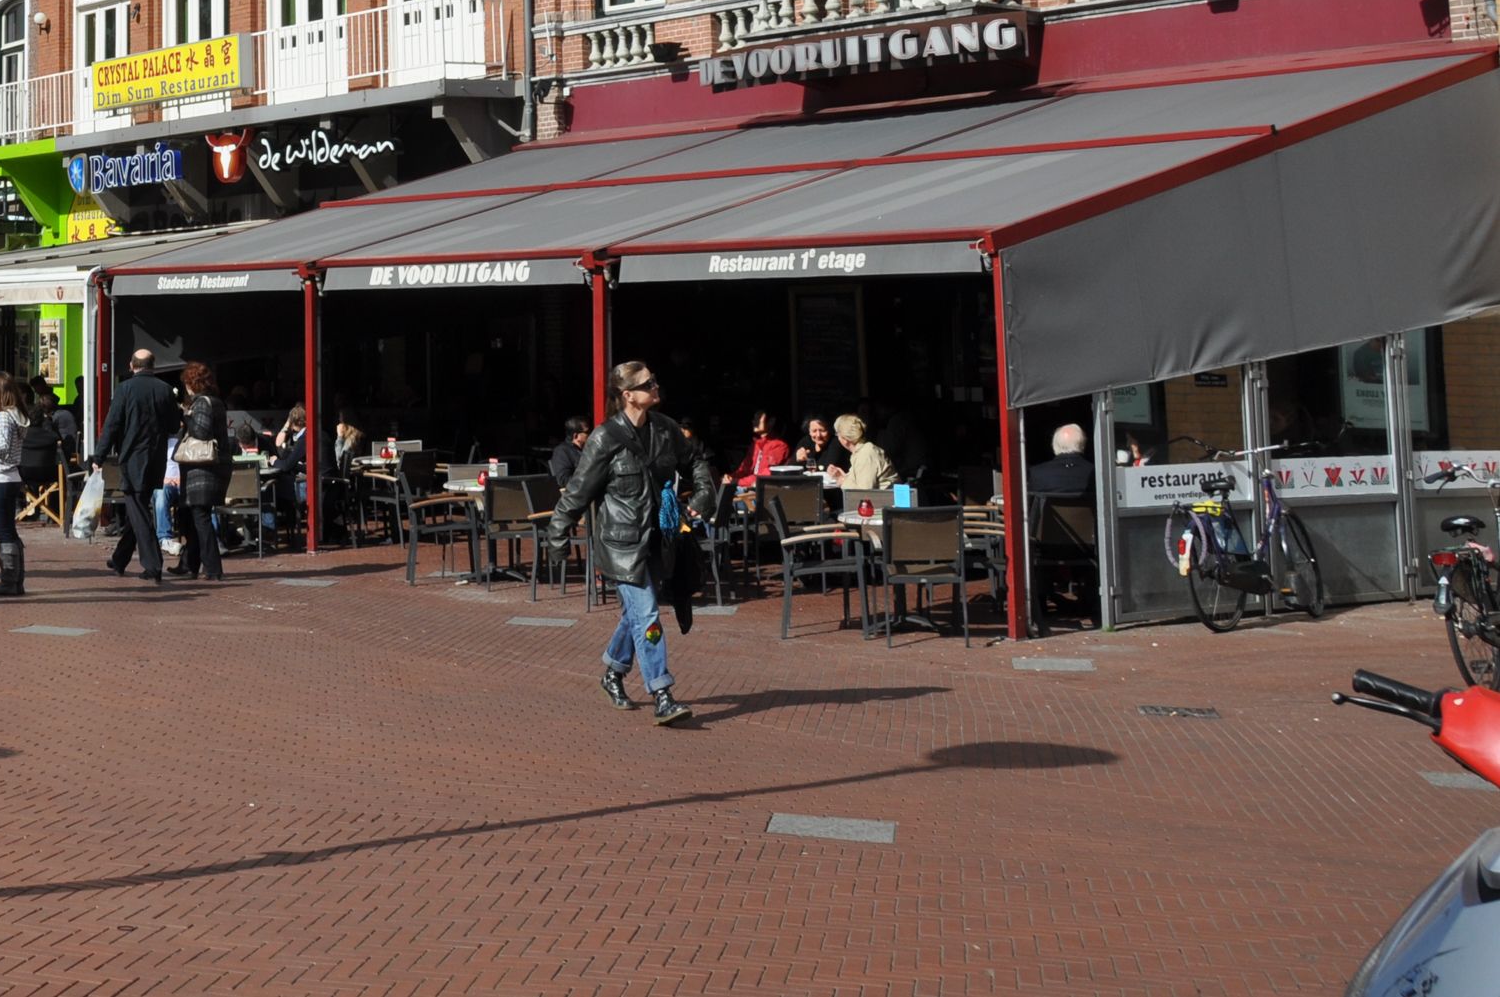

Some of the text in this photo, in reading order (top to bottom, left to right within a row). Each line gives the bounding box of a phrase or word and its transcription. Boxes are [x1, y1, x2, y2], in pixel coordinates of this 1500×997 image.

[700, 18, 1017, 87] DE VOORUITGANG
[97, 51, 182, 87] CRYSTAL PALACE
[97, 69, 236, 107] Dim Sum Restaurant
[258, 129, 395, 172] de wildeman
[89, 141, 177, 194] Bavaria
[369, 260, 530, 286] DE VOORUITGANG
[708, 252, 796, 273] Restaurant
[817, 251, 866, 273] etage
[200, 273, 249, 289] Restaurant
[1141, 470, 1224, 488] restaurant
[1177, 491, 1209, 500] verdiep
